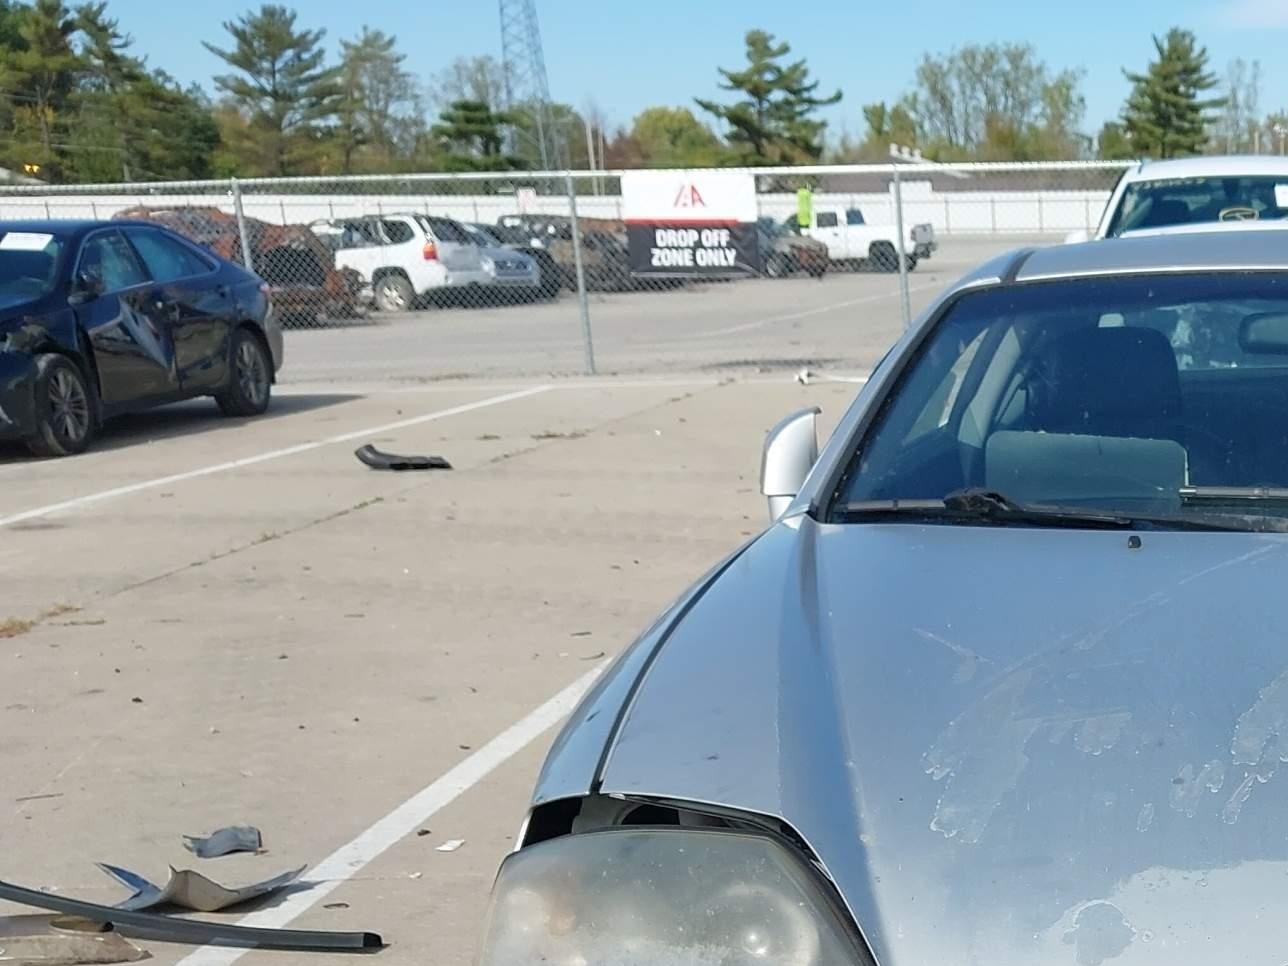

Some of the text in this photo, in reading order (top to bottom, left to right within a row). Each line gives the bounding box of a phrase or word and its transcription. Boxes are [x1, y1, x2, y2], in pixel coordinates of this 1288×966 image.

[655, 229, 731, 248] DROP OFF
[651, 247, 737, 267] ZONE ONLY
